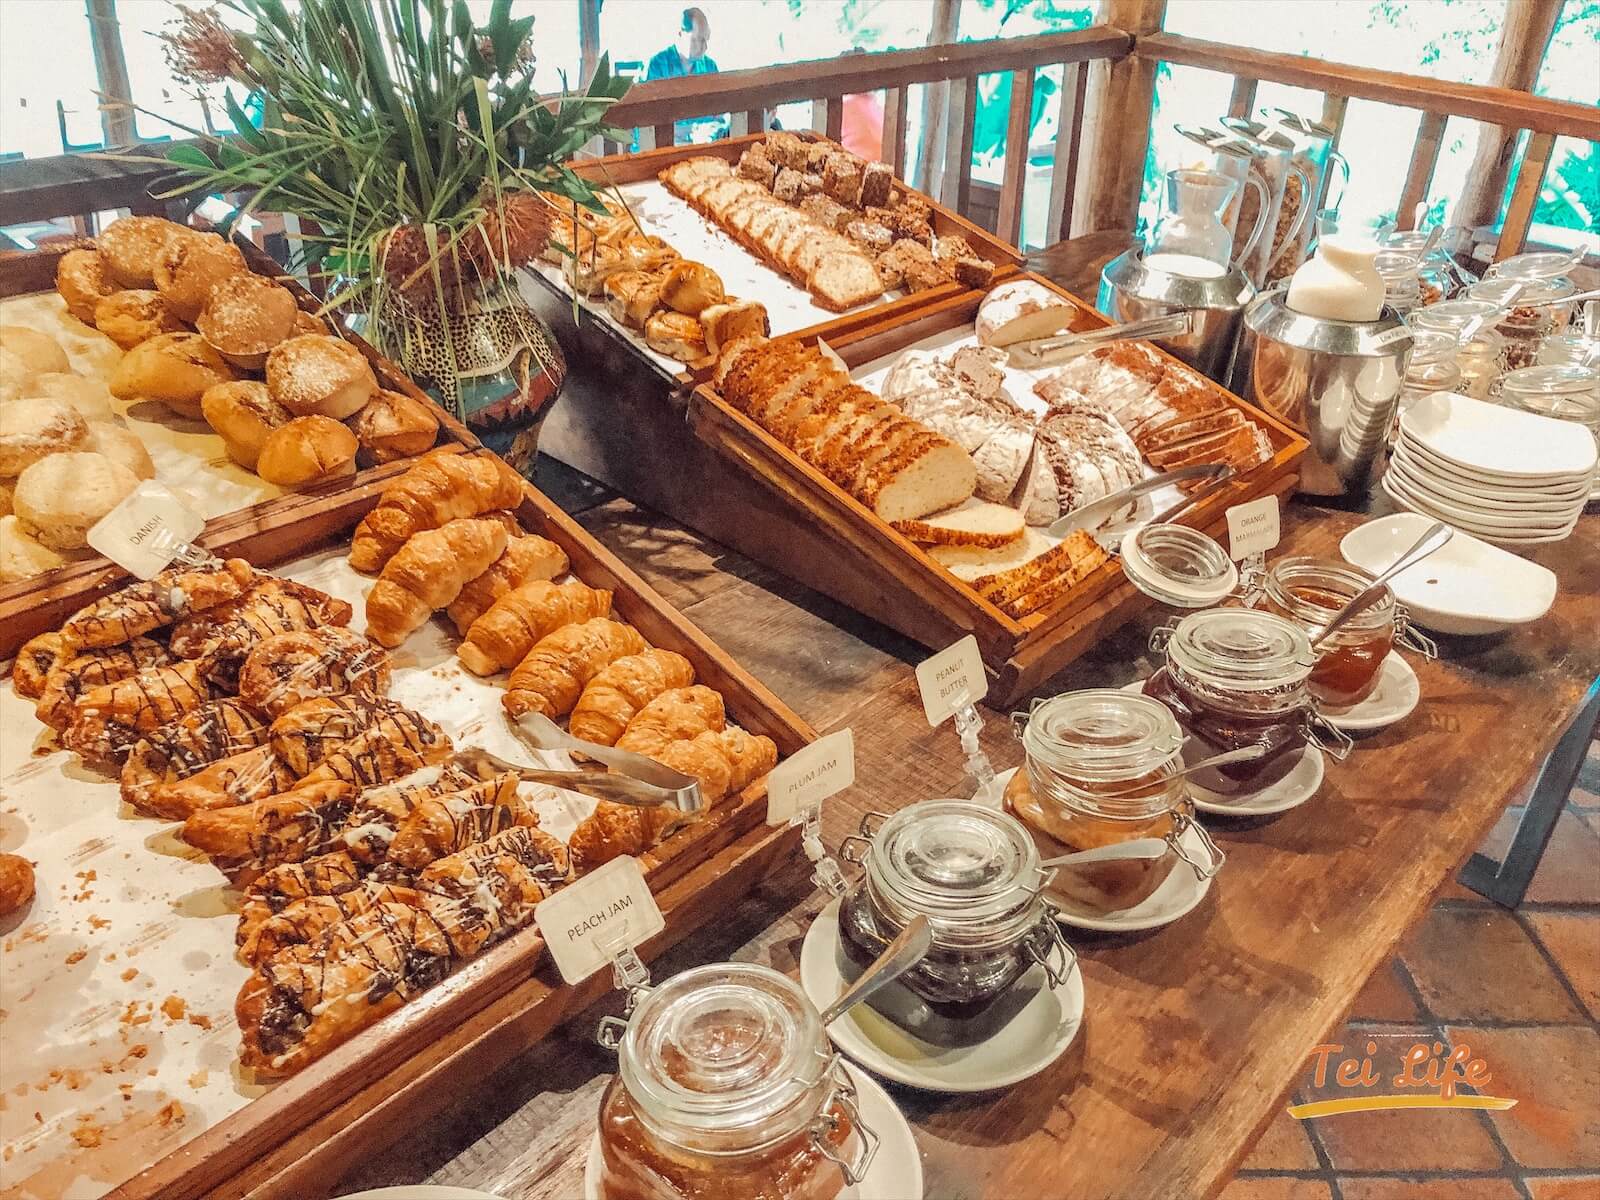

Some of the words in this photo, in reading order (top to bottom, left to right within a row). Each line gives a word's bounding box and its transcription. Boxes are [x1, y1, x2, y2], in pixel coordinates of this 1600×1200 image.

[129, 515, 163, 545] DANISH
[936, 658, 964, 682] PEANUT
[940, 675, 969, 698] BUTTER
[788, 770, 815, 793] PLUM
[817, 759, 838, 777] JAM
[567, 911, 607, 941] PEACH
[608, 895, 633, 917] JAM
